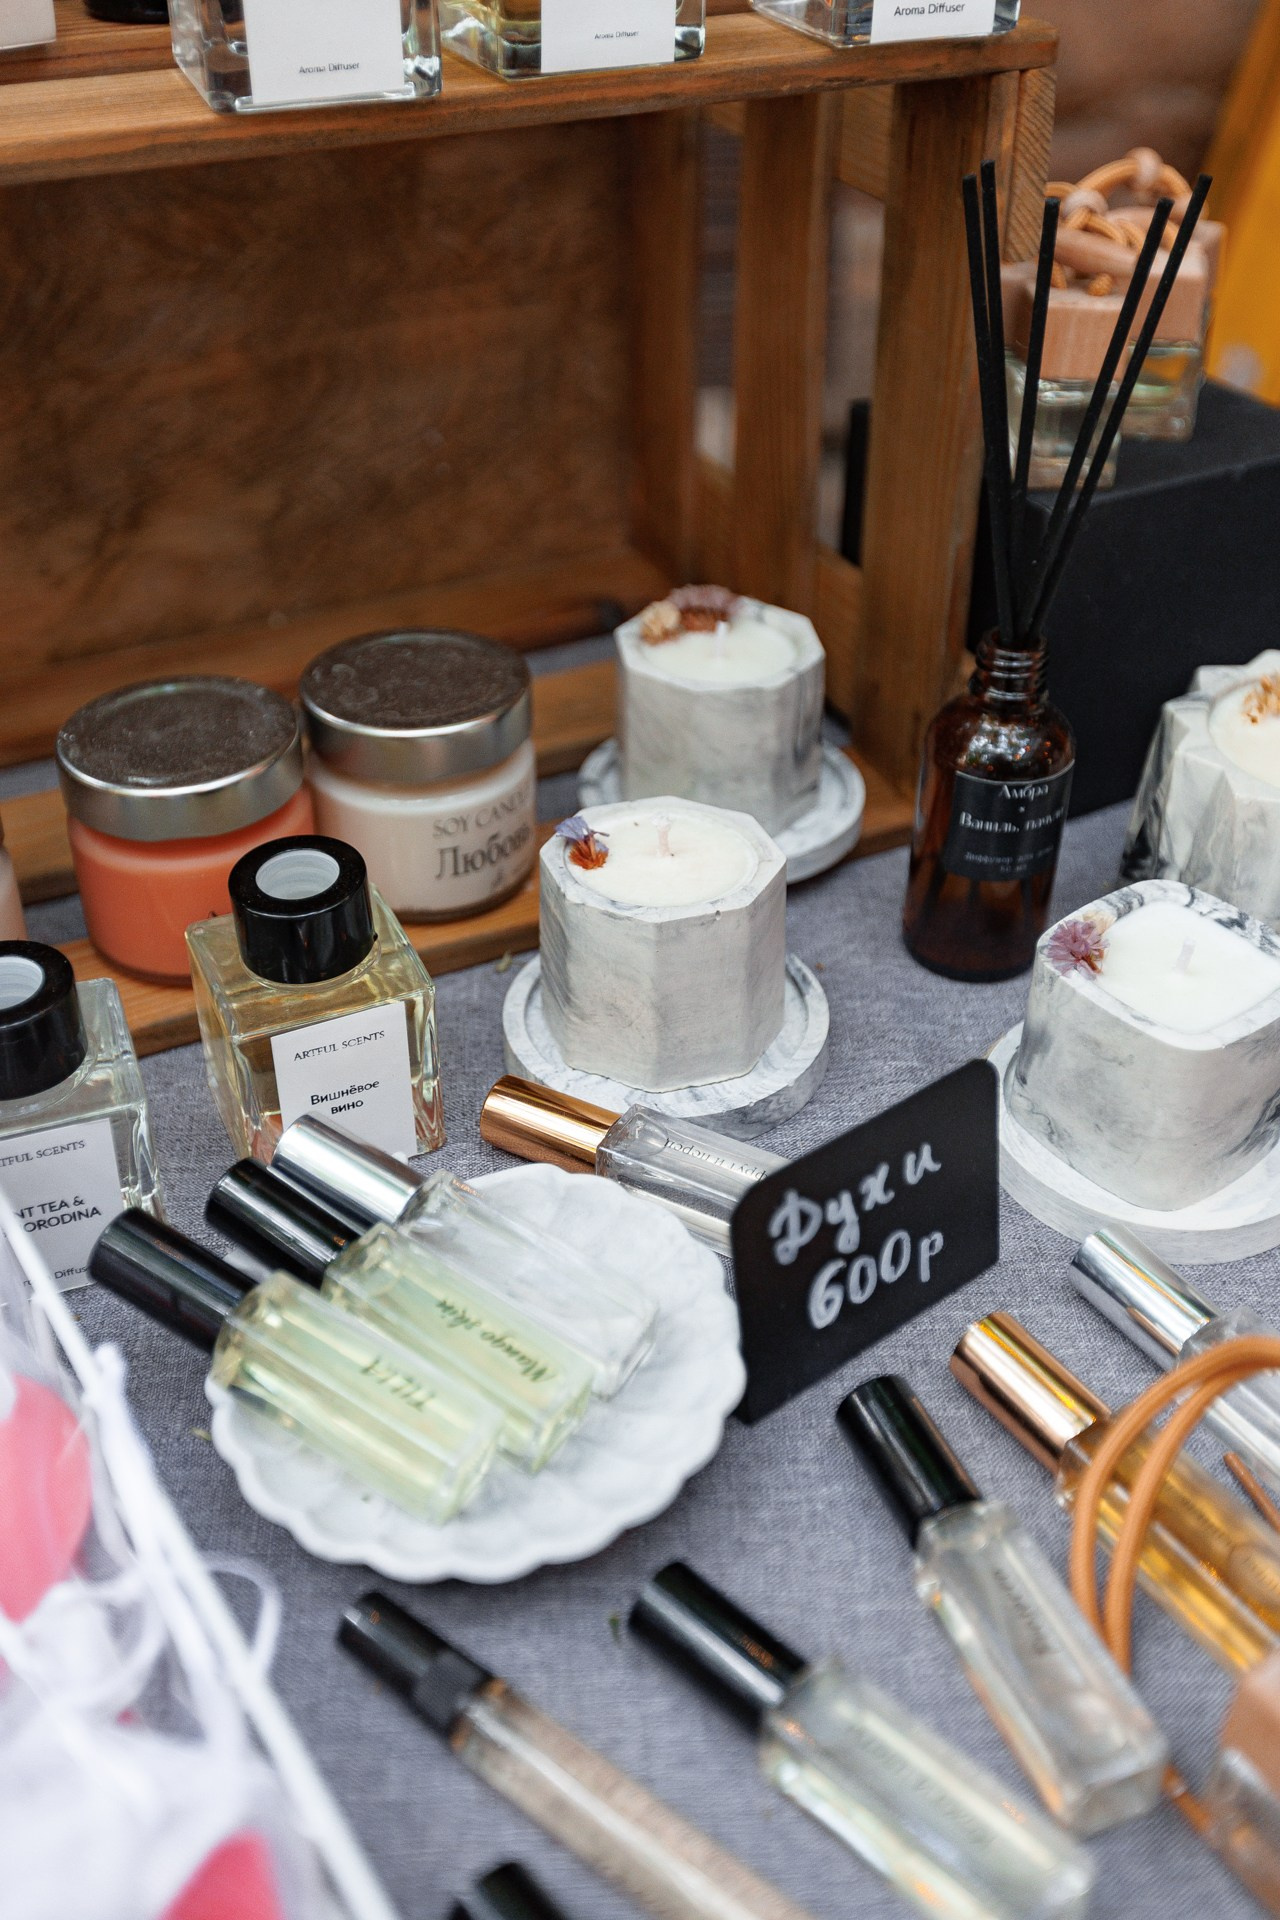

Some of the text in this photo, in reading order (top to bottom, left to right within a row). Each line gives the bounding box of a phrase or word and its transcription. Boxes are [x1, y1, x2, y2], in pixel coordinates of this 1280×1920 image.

[893, 2, 965, 16] Aroma Diffuser
[328, 62, 360, 71] Diffuser
[1000, 784, 1049, 801] Амбра
[433, 814, 471, 838] SOY
[294, 1030, 385, 1061] ARTFUL SCENTS
[310, 1080, 380, 1106] Вишнёвое
[331, 1100, 364, 1115] вино
[0, 1140, 85, 1167] TFUL SCENTS
[37, 1199, 70, 1215] TEA
[73, 1195, 85, 1206] &
[768, 1142, 942, 1265] Духи
[23, 1206, 102, 1233] ORODINA
[54, 1266, 88, 1280] Diffus
